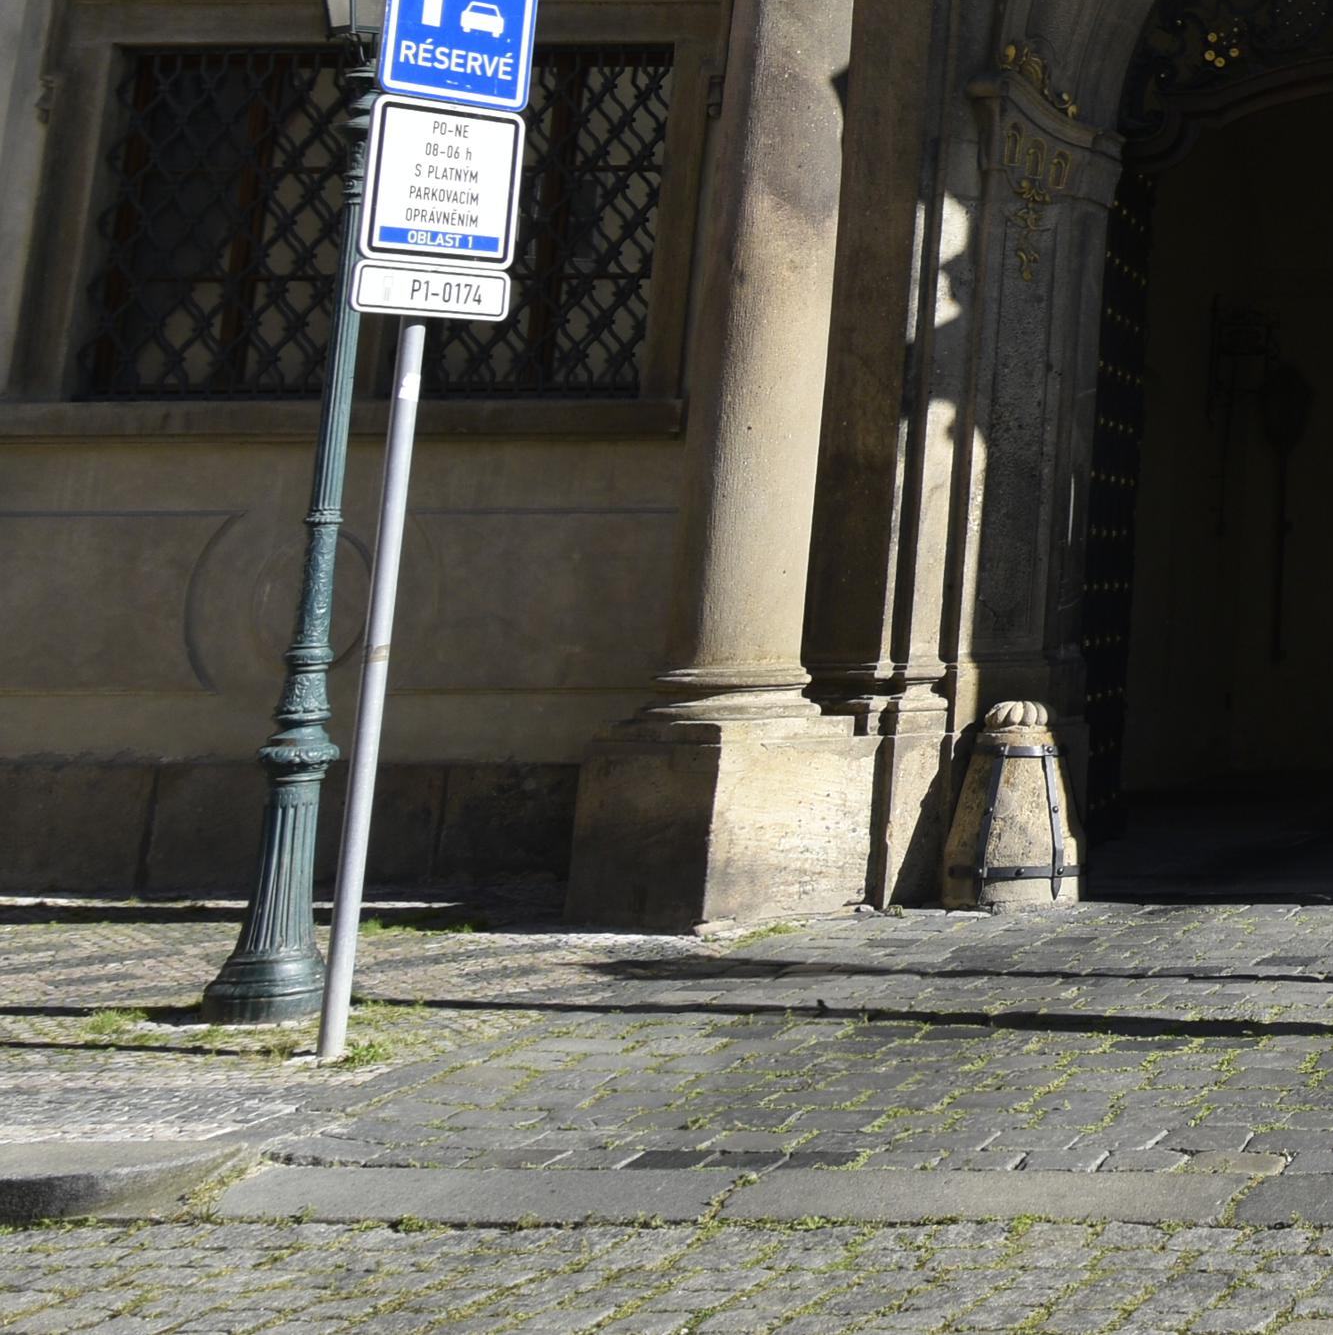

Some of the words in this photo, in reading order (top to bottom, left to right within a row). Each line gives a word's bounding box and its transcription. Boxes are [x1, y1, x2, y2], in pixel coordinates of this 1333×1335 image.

[400, 38, 514, 81] RÉSERVÉ
[432, 120, 470, 139] PO-NE
[425, 142, 460, 160] 08-06
[465, 148, 473, 161] h
[414, 163, 423, 177] S
[427, 164, 479, 184] PLATNÝM
[409, 185, 479, 206] PARKOVACÍM
[405, 206, 479, 228] OPRÁVNĚNÍM
[407, 230, 463, 248] OBLAST
[467, 235, 474, 249] 1
[410, 278, 482, 306] P1-0174
